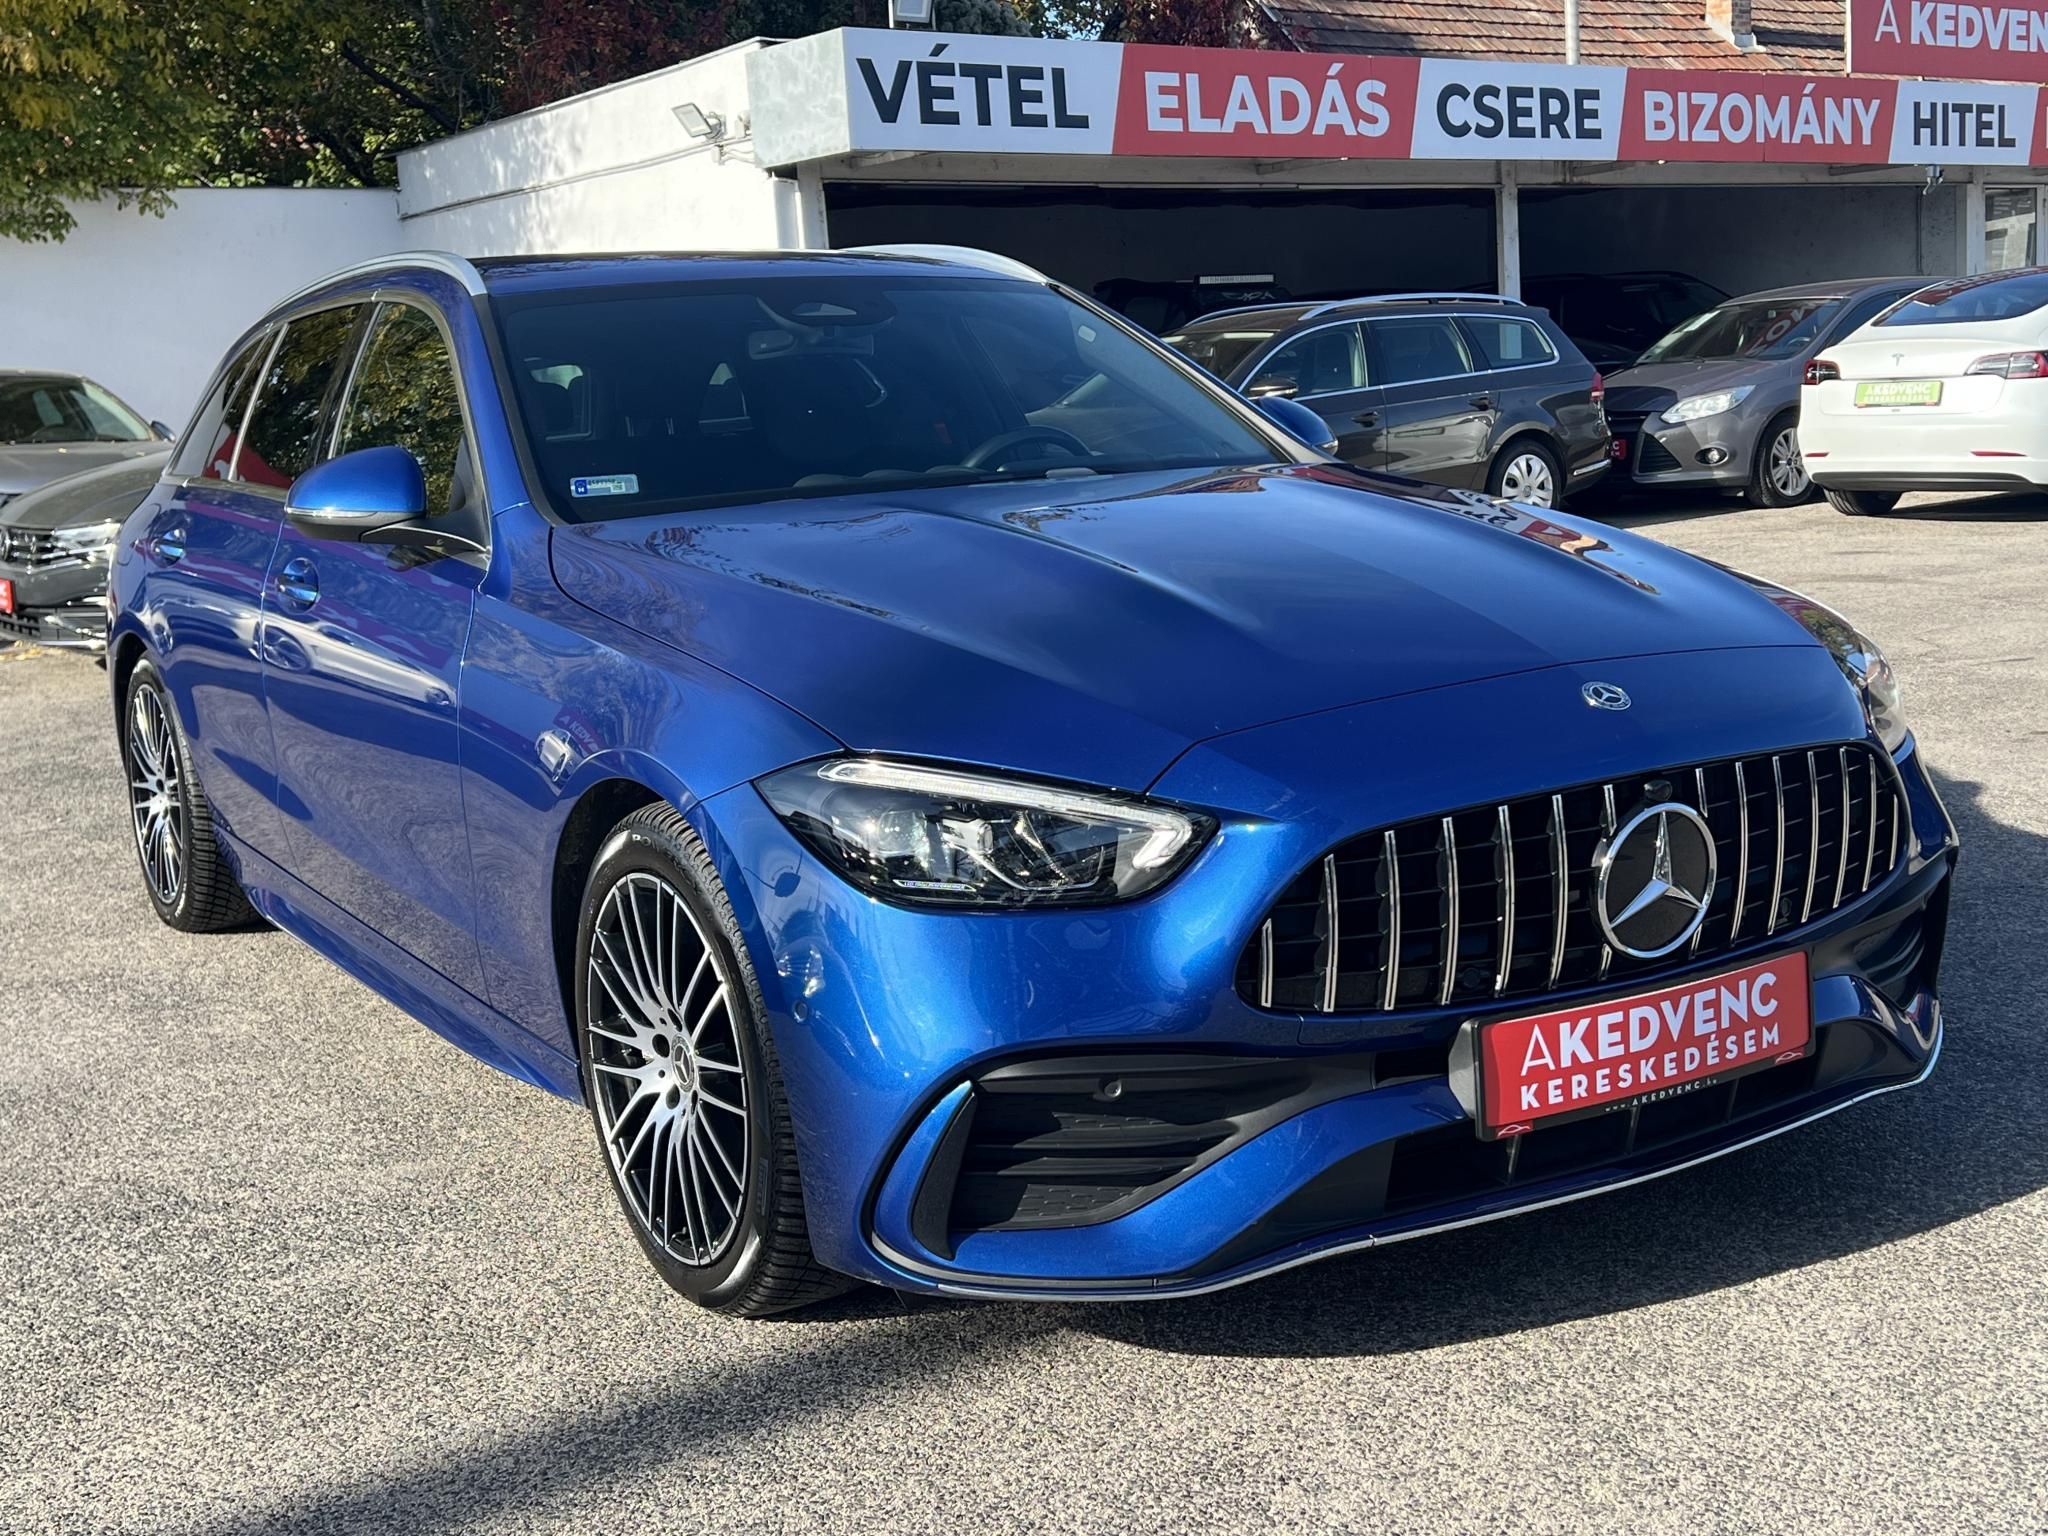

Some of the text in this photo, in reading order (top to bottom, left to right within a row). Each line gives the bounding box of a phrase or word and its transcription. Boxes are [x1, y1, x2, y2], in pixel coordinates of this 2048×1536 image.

[1875, 0, 1901, 43] A
[856, 44, 1090, 130] VÉTEL
[1144, 62, 1390, 138] ELADÁS
[1436, 83, 1602, 139] CSERE
[1644, 83, 1880, 146] BIZOMÁNY
[1913, 101, 2016, 148] HITEL
[1520, 1022, 1780, 1111] KERESKEDÉSEM
